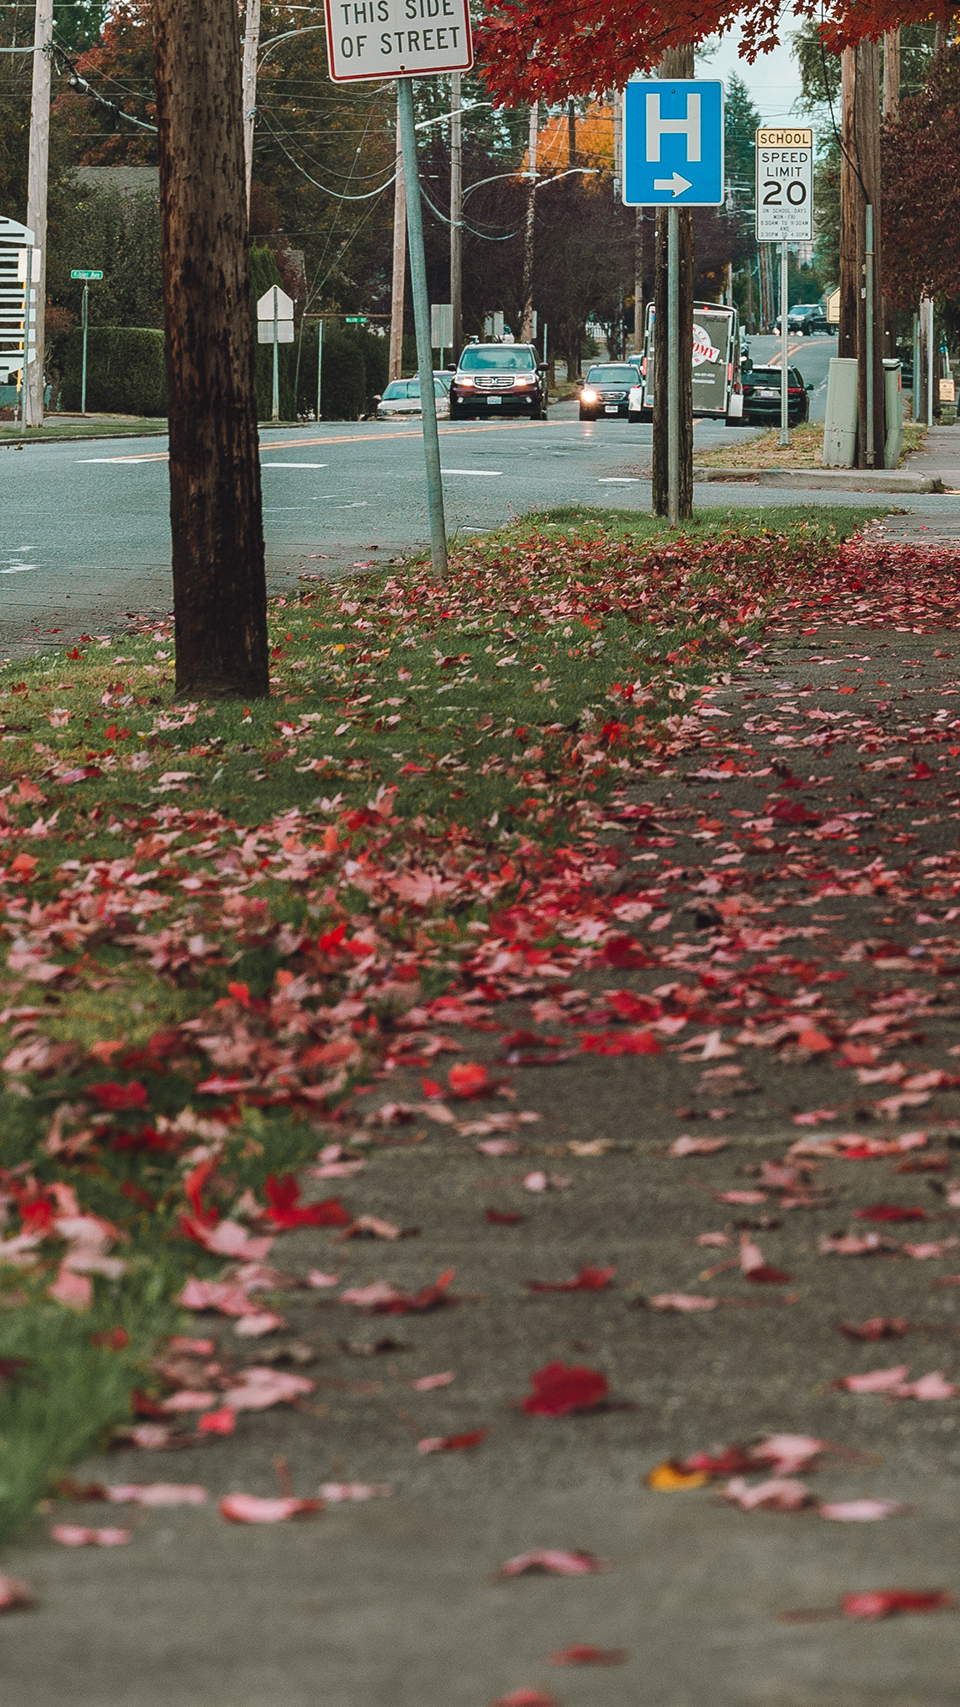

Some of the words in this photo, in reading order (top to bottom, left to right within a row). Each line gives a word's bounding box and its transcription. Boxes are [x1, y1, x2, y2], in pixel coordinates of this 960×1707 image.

[341, 0, 389, 25] THIS
[341, 35, 367, 58] OF
[380, 26, 460, 54] STREET
[646, 94, 701, 162] H
[760, 133, 809, 144] SCHOOL
[762, 152, 808, 163] SPEED
[766, 166, 802, 177] LIMIT
[763, 180, 807, 205] 20
